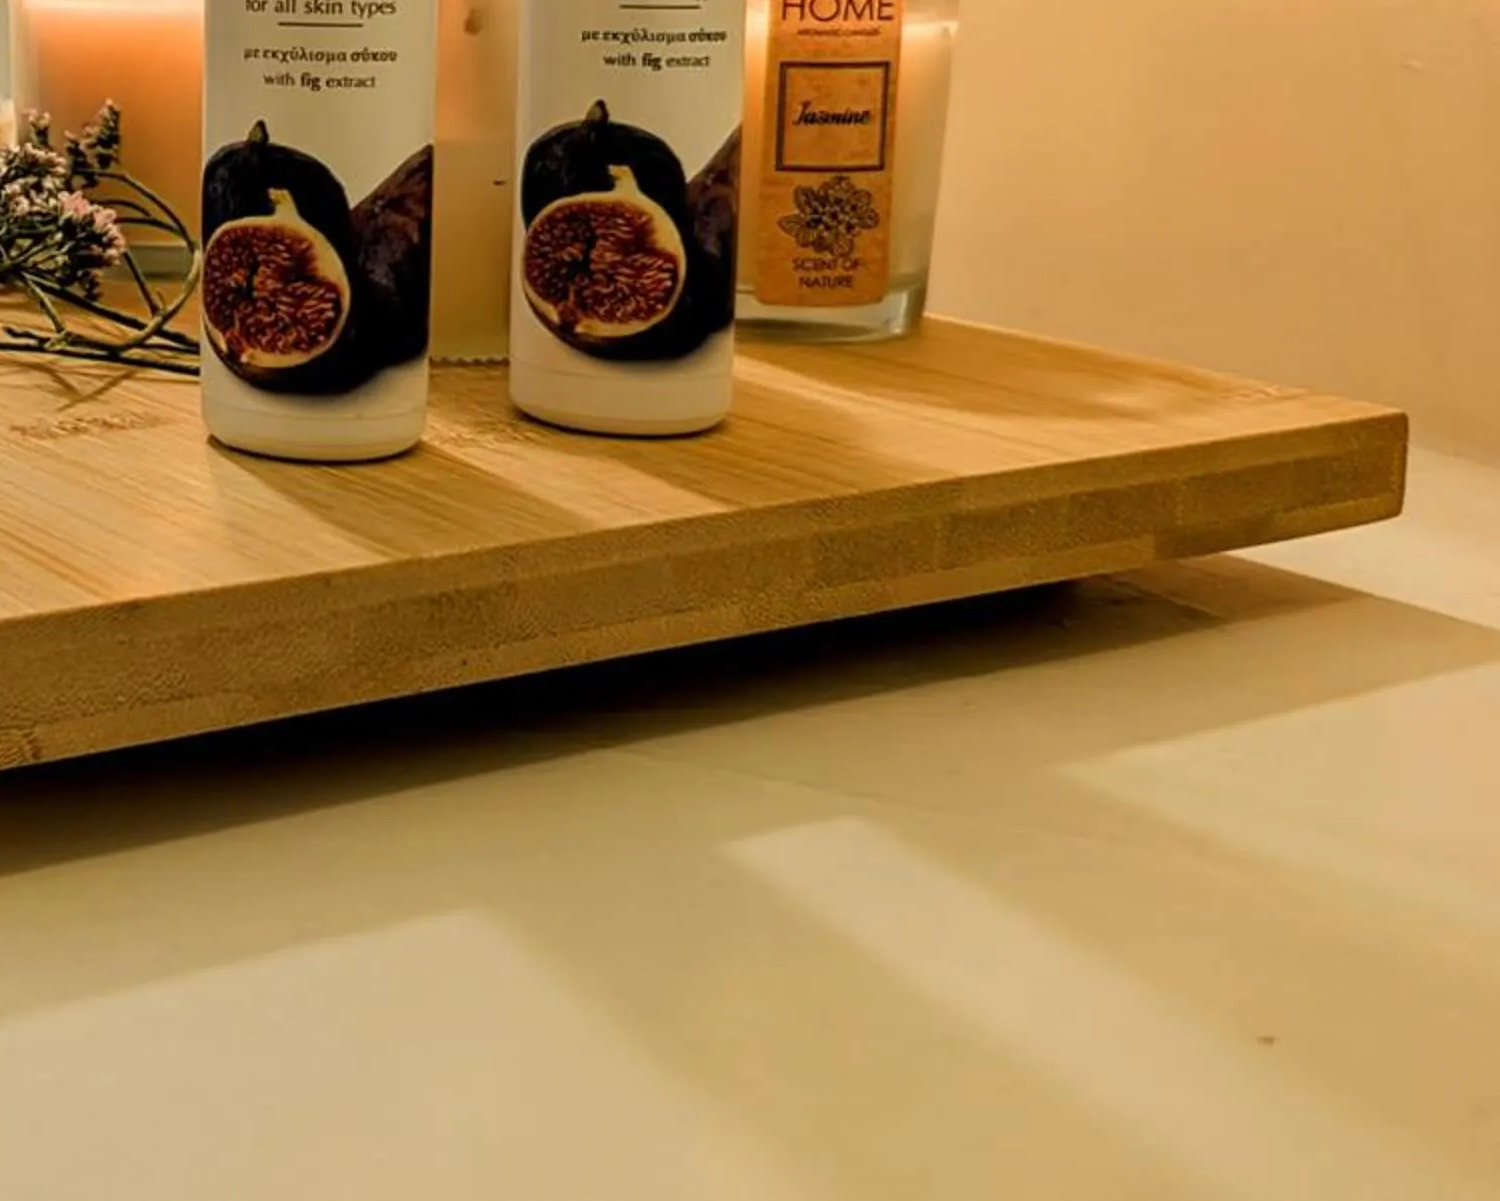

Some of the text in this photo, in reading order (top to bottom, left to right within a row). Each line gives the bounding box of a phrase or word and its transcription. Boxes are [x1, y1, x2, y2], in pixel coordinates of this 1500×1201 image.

[351, 0, 397, 19] types
[603, 54, 710, 70] with fig extract
[263, 73, 376, 91] with fig extract
[792, 100, 871, 126] Jasmine
[792, 258, 839, 272] SCENT
[799, 275, 854, 288] NATURE
